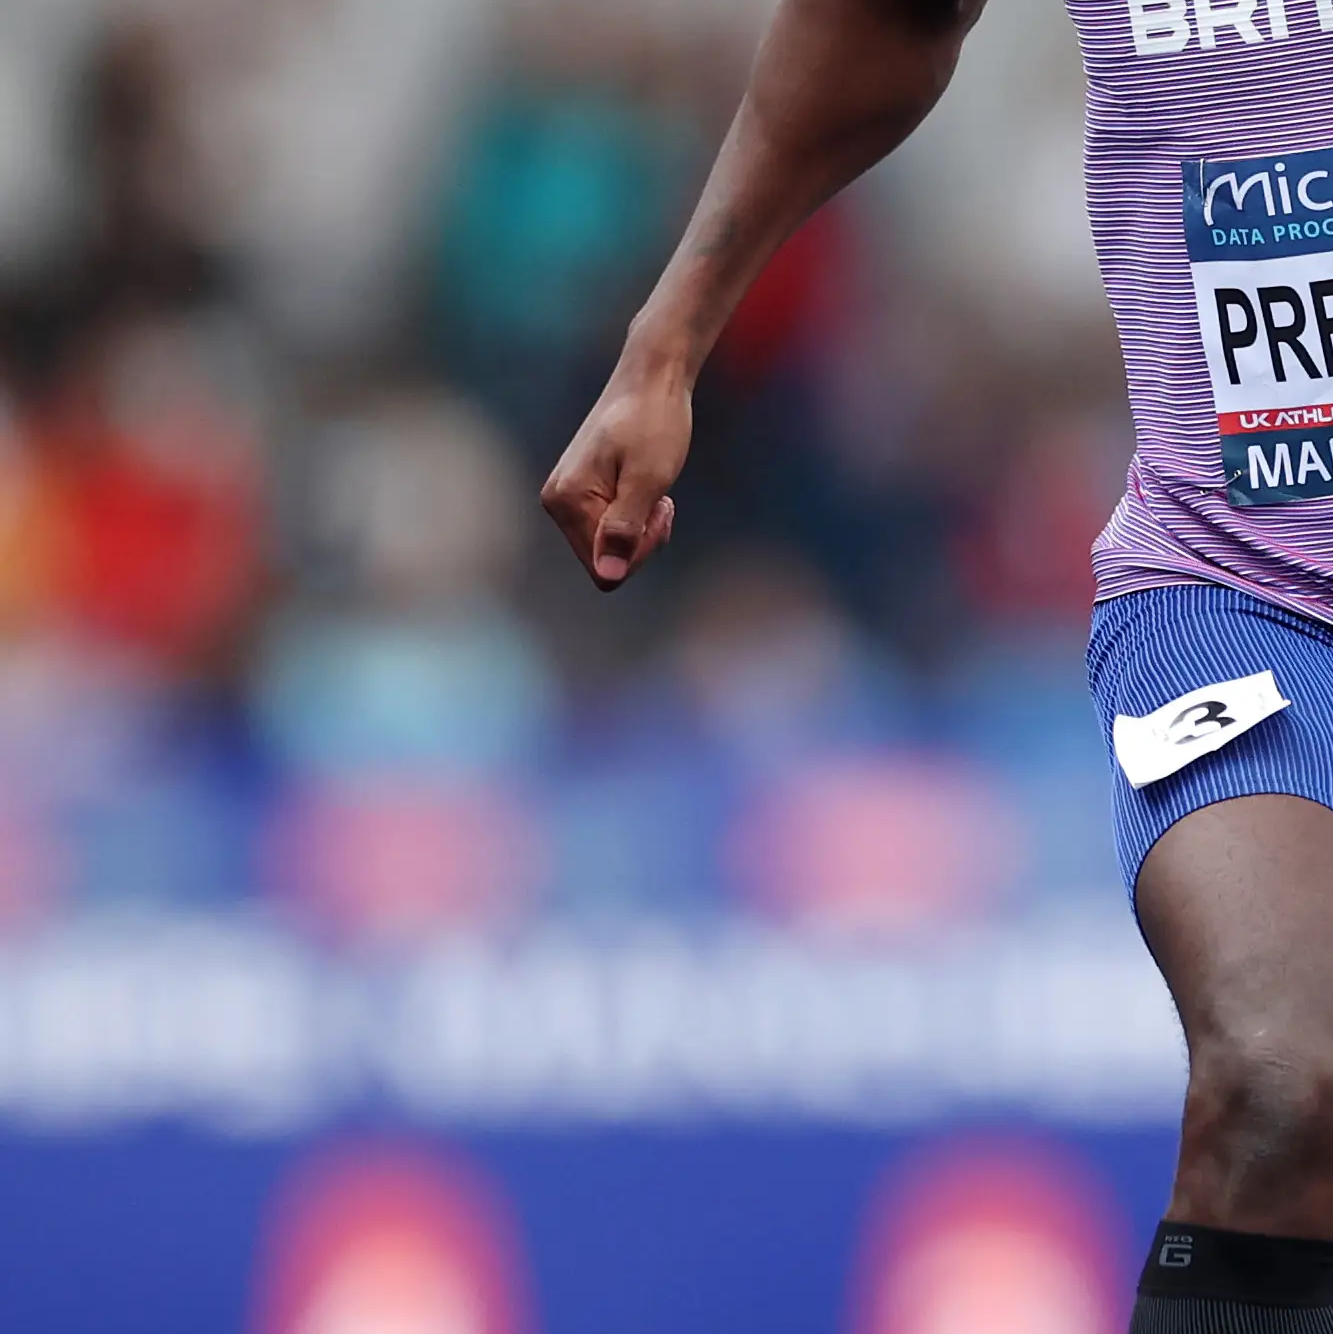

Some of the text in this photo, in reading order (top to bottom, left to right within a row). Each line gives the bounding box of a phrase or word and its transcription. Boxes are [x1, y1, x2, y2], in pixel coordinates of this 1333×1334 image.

[1212, 227, 1265, 246] DATA
[1240, 413, 1270, 428] UK
[1169, 701, 1236, 745] 3
